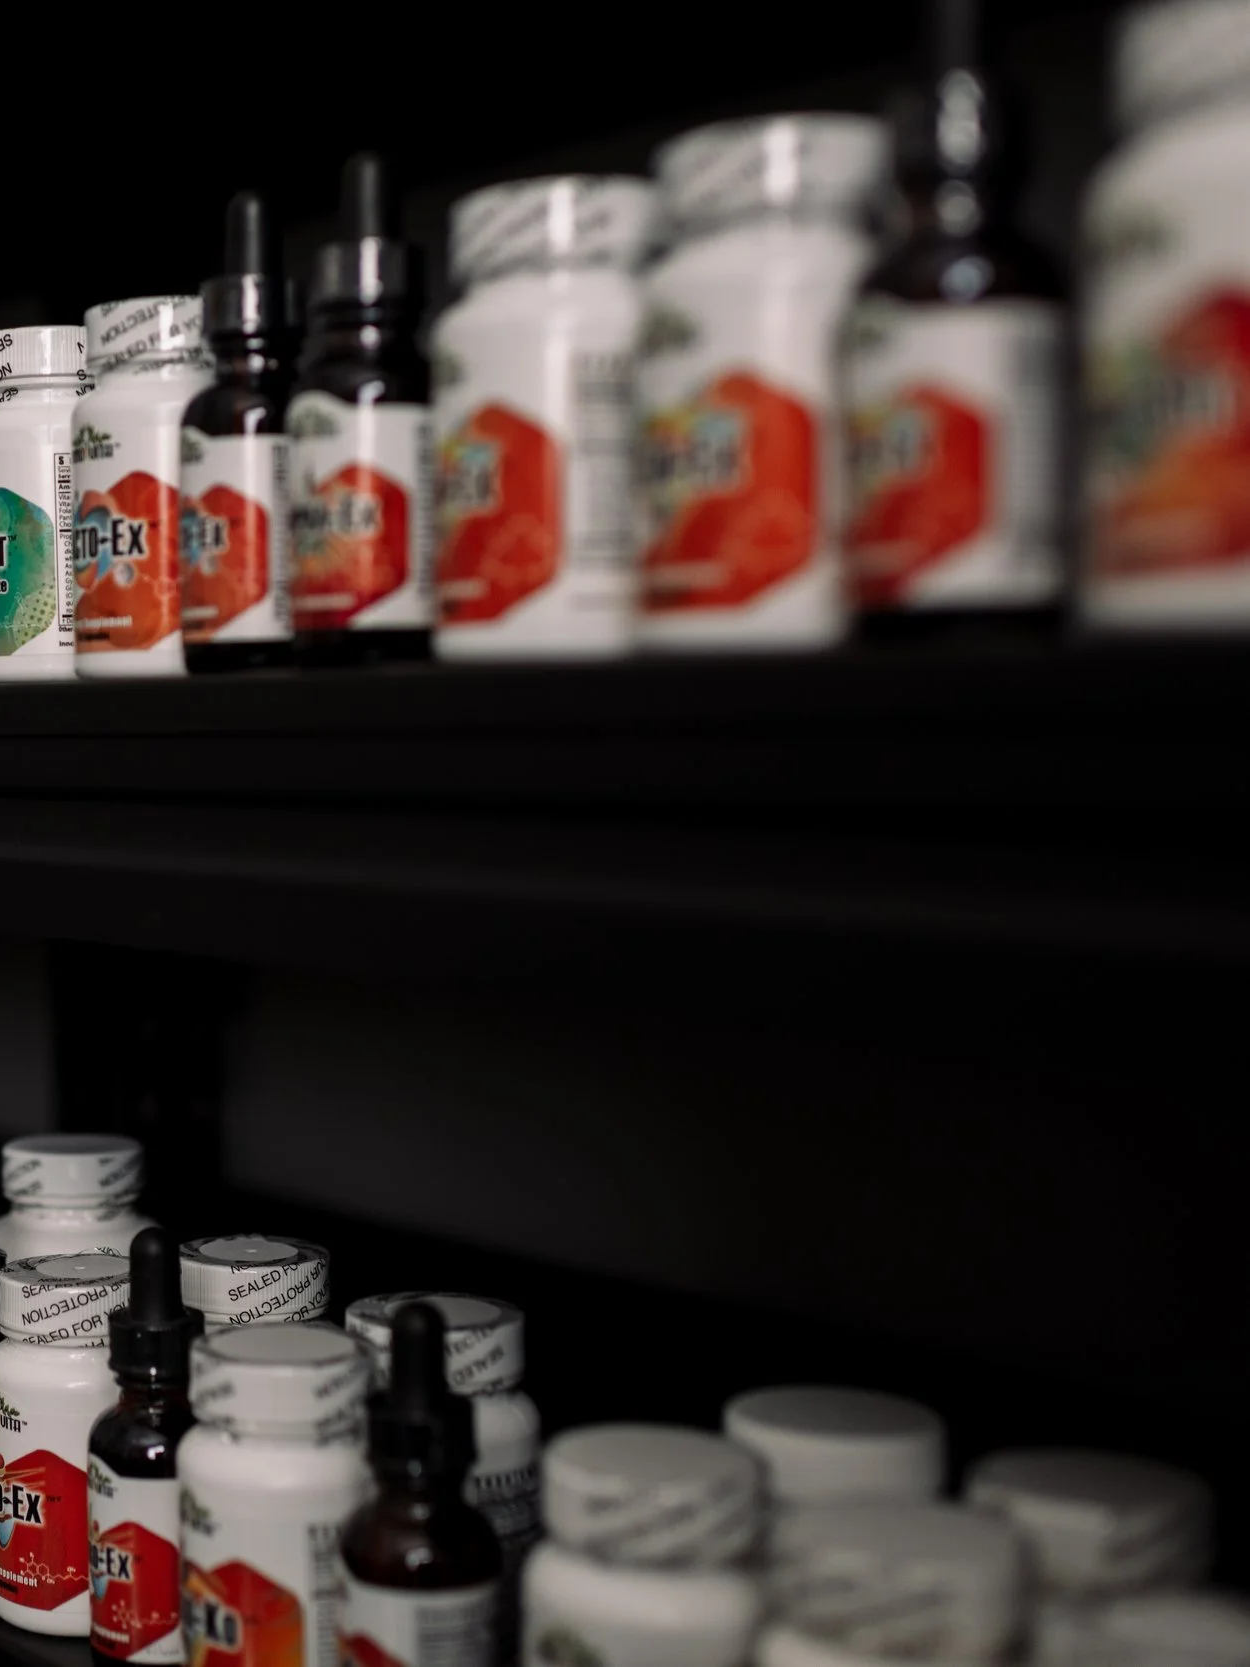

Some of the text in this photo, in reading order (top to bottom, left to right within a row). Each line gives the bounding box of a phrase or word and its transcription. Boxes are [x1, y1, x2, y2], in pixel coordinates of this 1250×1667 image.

[228, 1269, 281, 1302] SEALED
[228, 1275, 312, 1326] PROTECTION
[21, 1285, 108, 1326] PROTECTION
[71, 1314, 104, 1337] FOR
